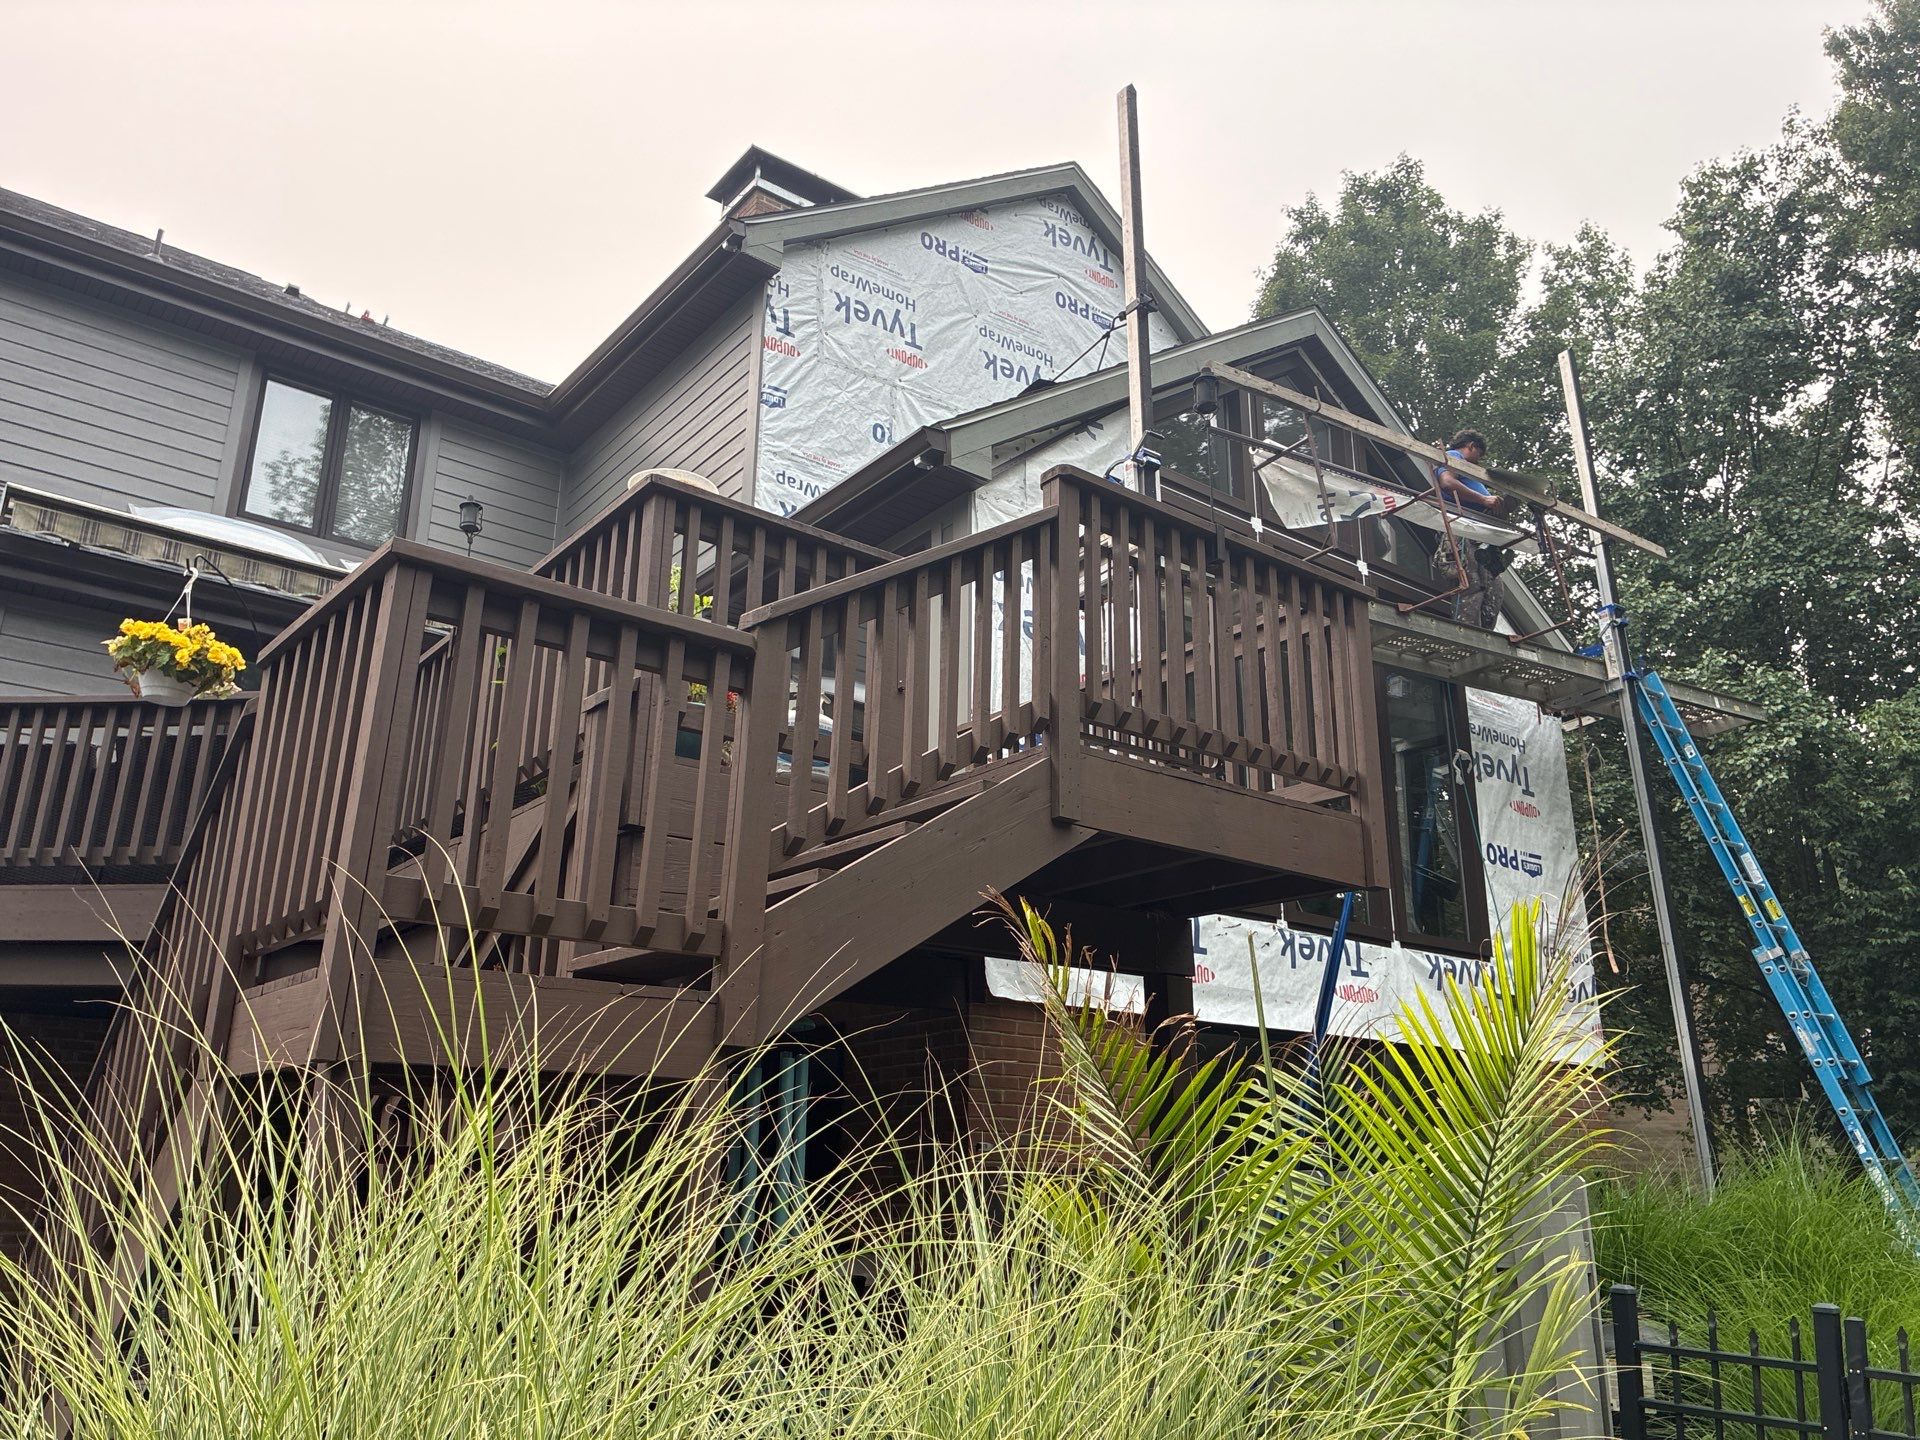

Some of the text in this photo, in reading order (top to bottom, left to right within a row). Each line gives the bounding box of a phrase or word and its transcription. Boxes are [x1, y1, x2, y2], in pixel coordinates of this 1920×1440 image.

[920, 231, 960, 263] PRO
[1043, 220, 1114, 274] Tyvek
[830, 264, 916, 312] HomeWrap
[1088, 269, 1115, 289] DUPONT
[833, 291, 923, 351] Tyvek
[1055, 291, 1090, 321] PRO
[764, 336, 796, 358] DUPON
[890, 348, 924, 369] DUPONT
[979, 325, 1053, 369] HomeWrap
[1469, 722, 1526, 754] HomeWra
[1512, 800, 1538, 818] DUPONT
[1486, 842, 1519, 871] PRO
[1339, 984, 1376, 1004] DUPONT
